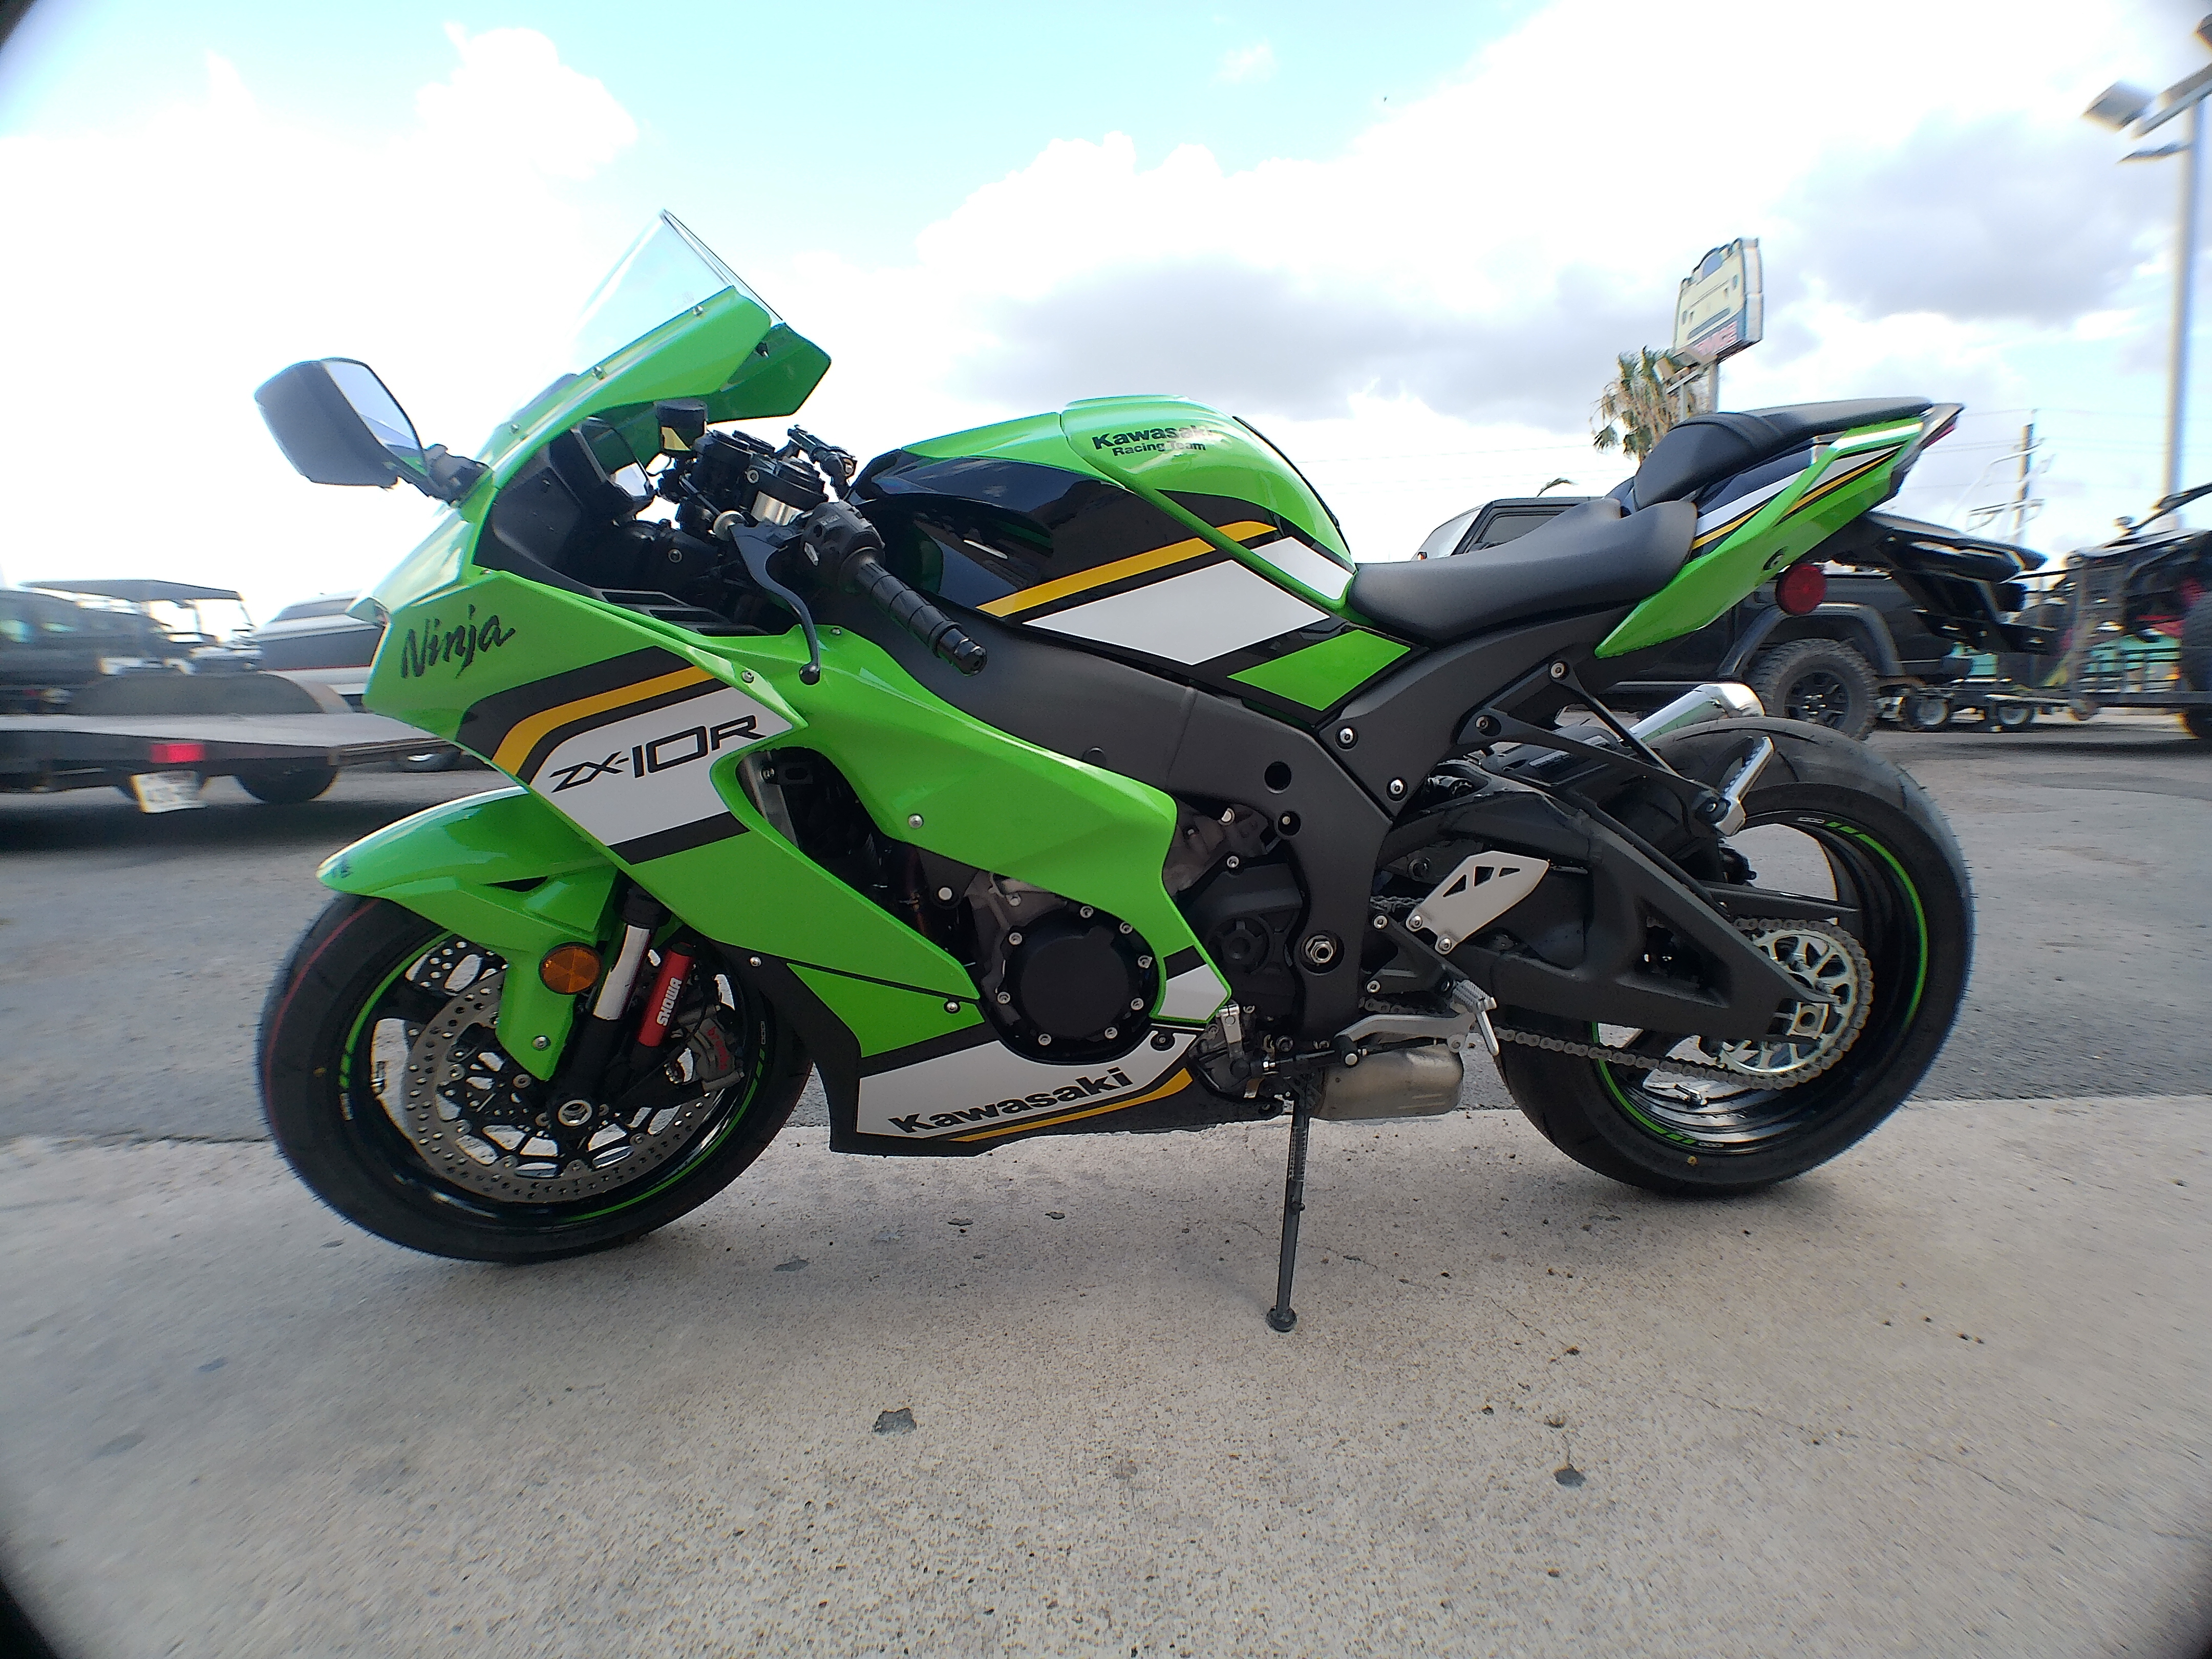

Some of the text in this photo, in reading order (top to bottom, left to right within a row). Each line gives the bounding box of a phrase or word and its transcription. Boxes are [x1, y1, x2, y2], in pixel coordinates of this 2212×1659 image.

[1092, 425, 1213, 450] Kawasaki
[1112, 440, 1206, 456] Racing Team
[400, 604, 516, 679] Ninja
[548, 715, 767, 793] ZX-10R
[656, 976, 683, 1026] SHOWA
[888, 1067, 1134, 1134] Kawasaki
